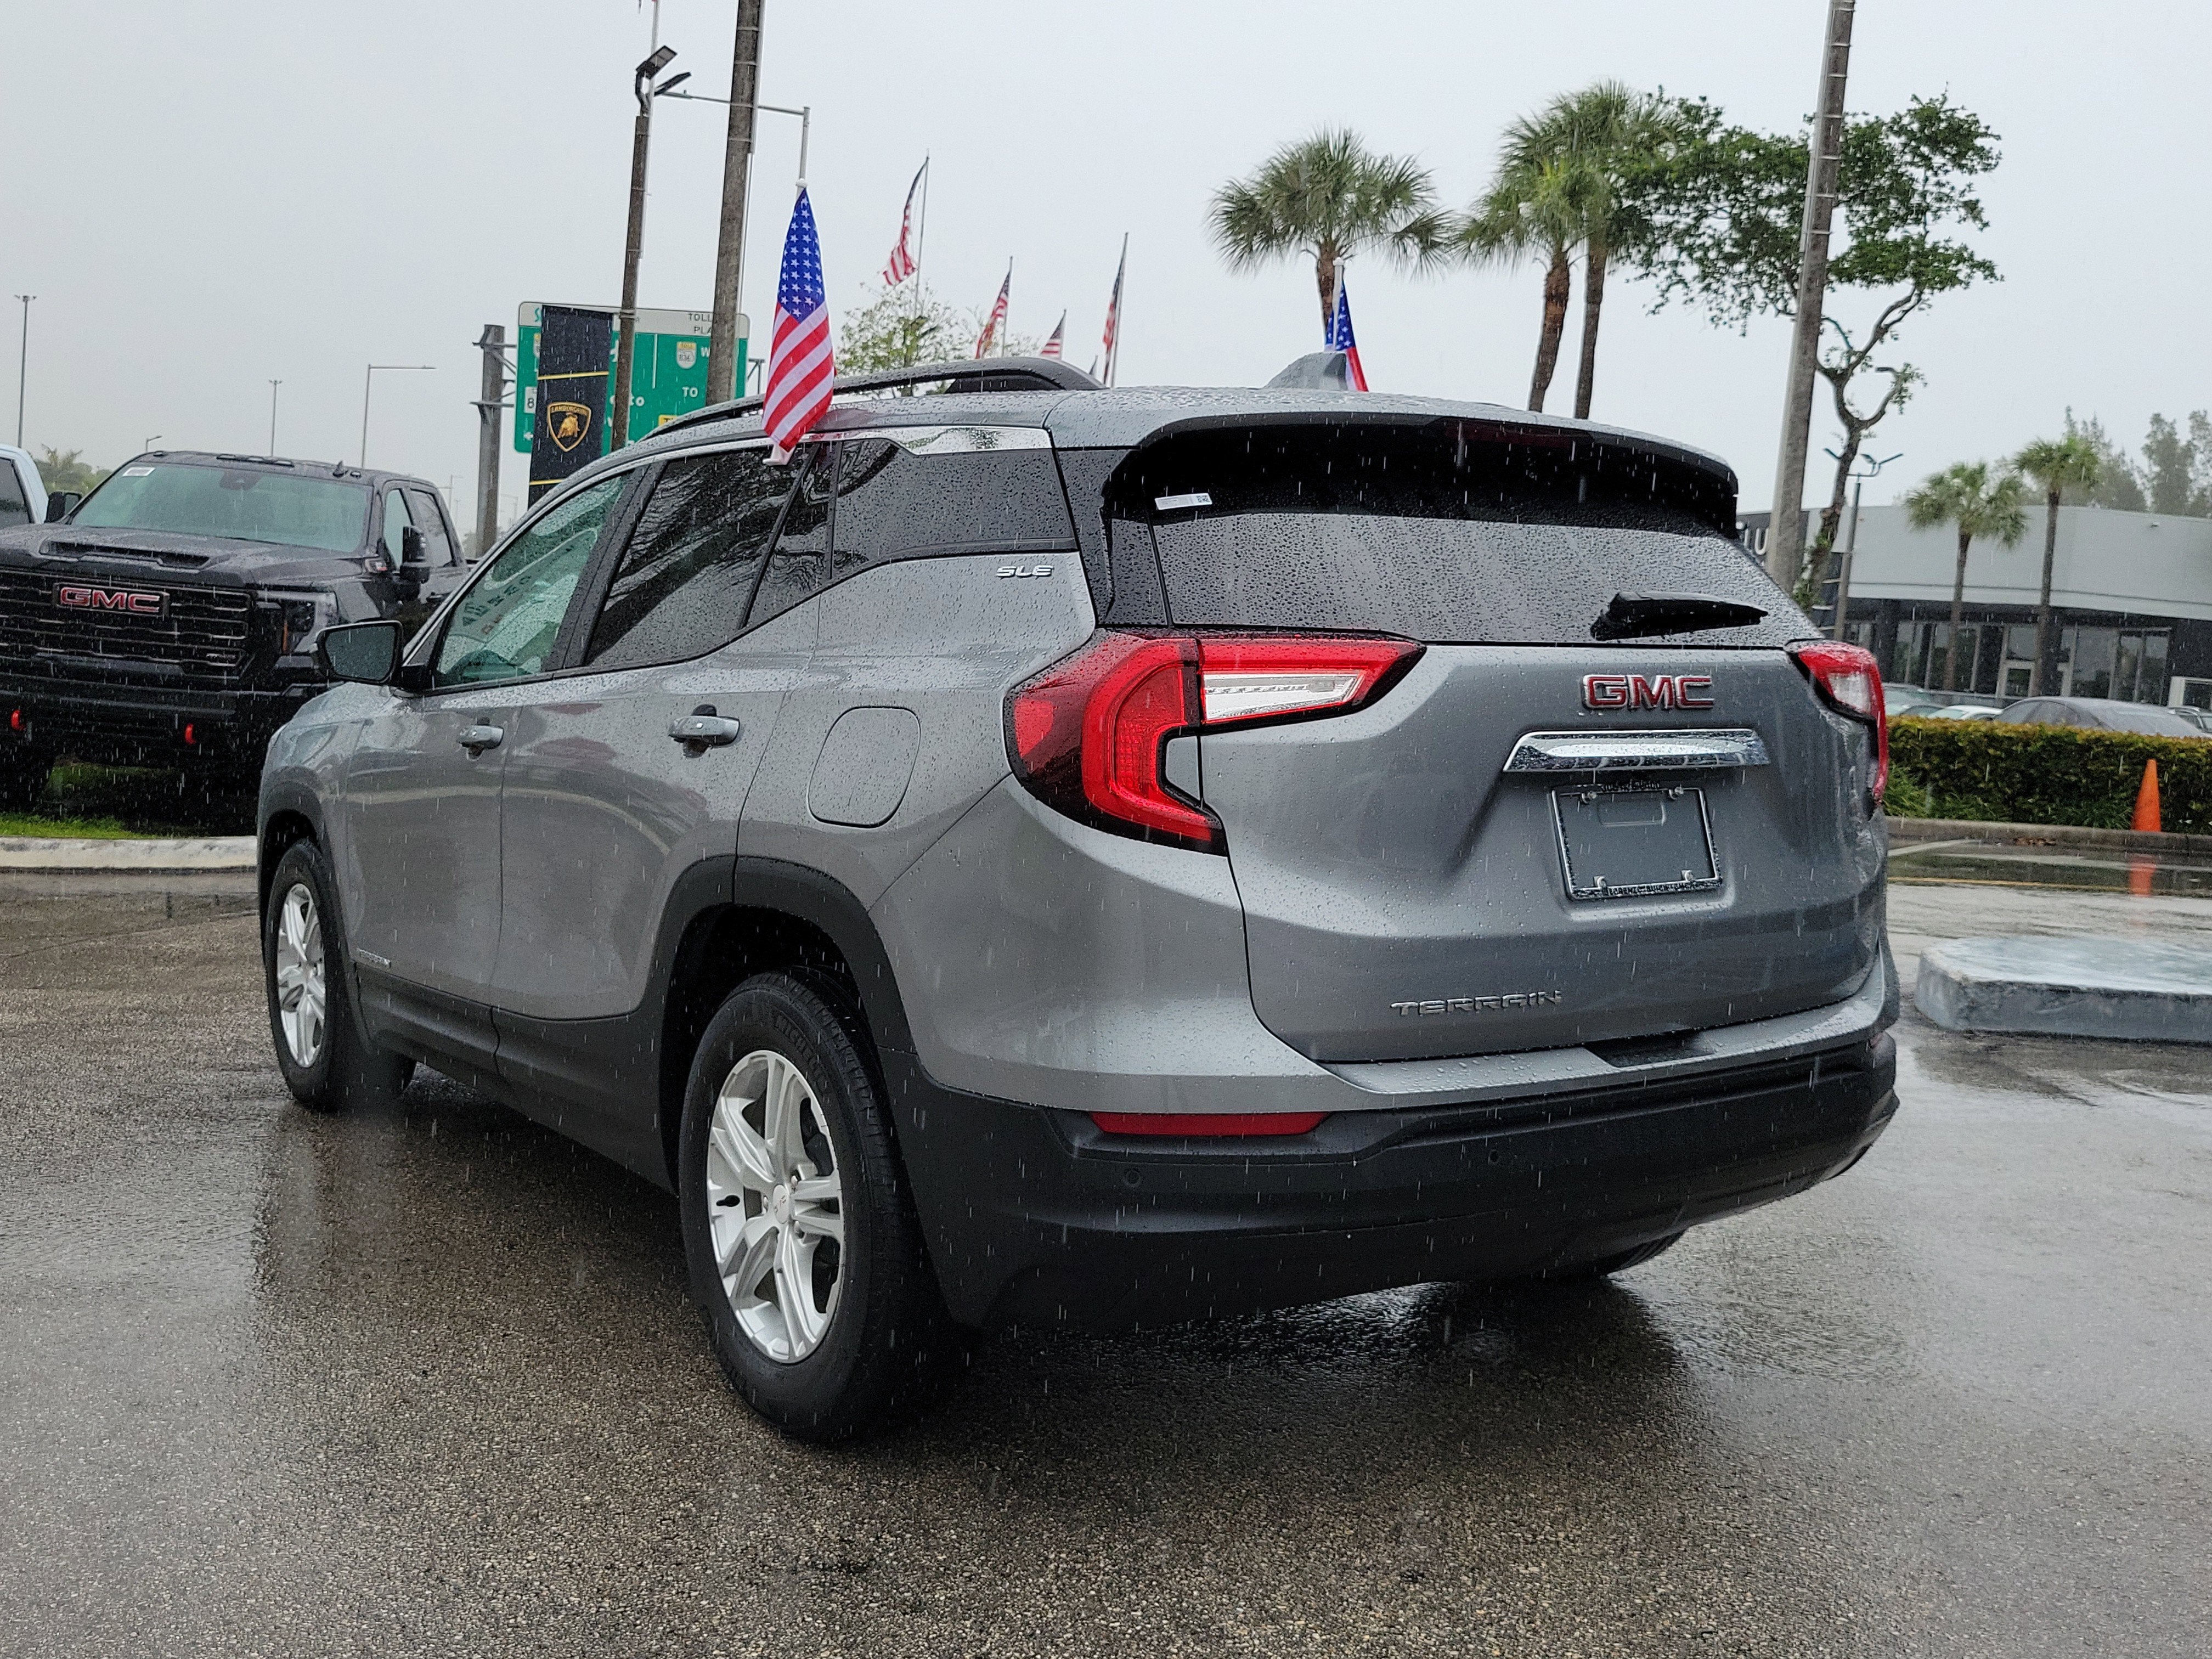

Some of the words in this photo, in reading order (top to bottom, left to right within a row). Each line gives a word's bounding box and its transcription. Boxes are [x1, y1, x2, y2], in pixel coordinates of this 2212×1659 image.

[689, 313, 713, 322] TOLL
[694, 326, 712, 335] PLA
[682, 386, 698, 398] TO
[996, 565, 1054, 577] SLE
[60, 586, 160, 613] GMC
[1583, 674, 1714, 710] GMC
[1390, 990, 1562, 1015] TERRAIN
